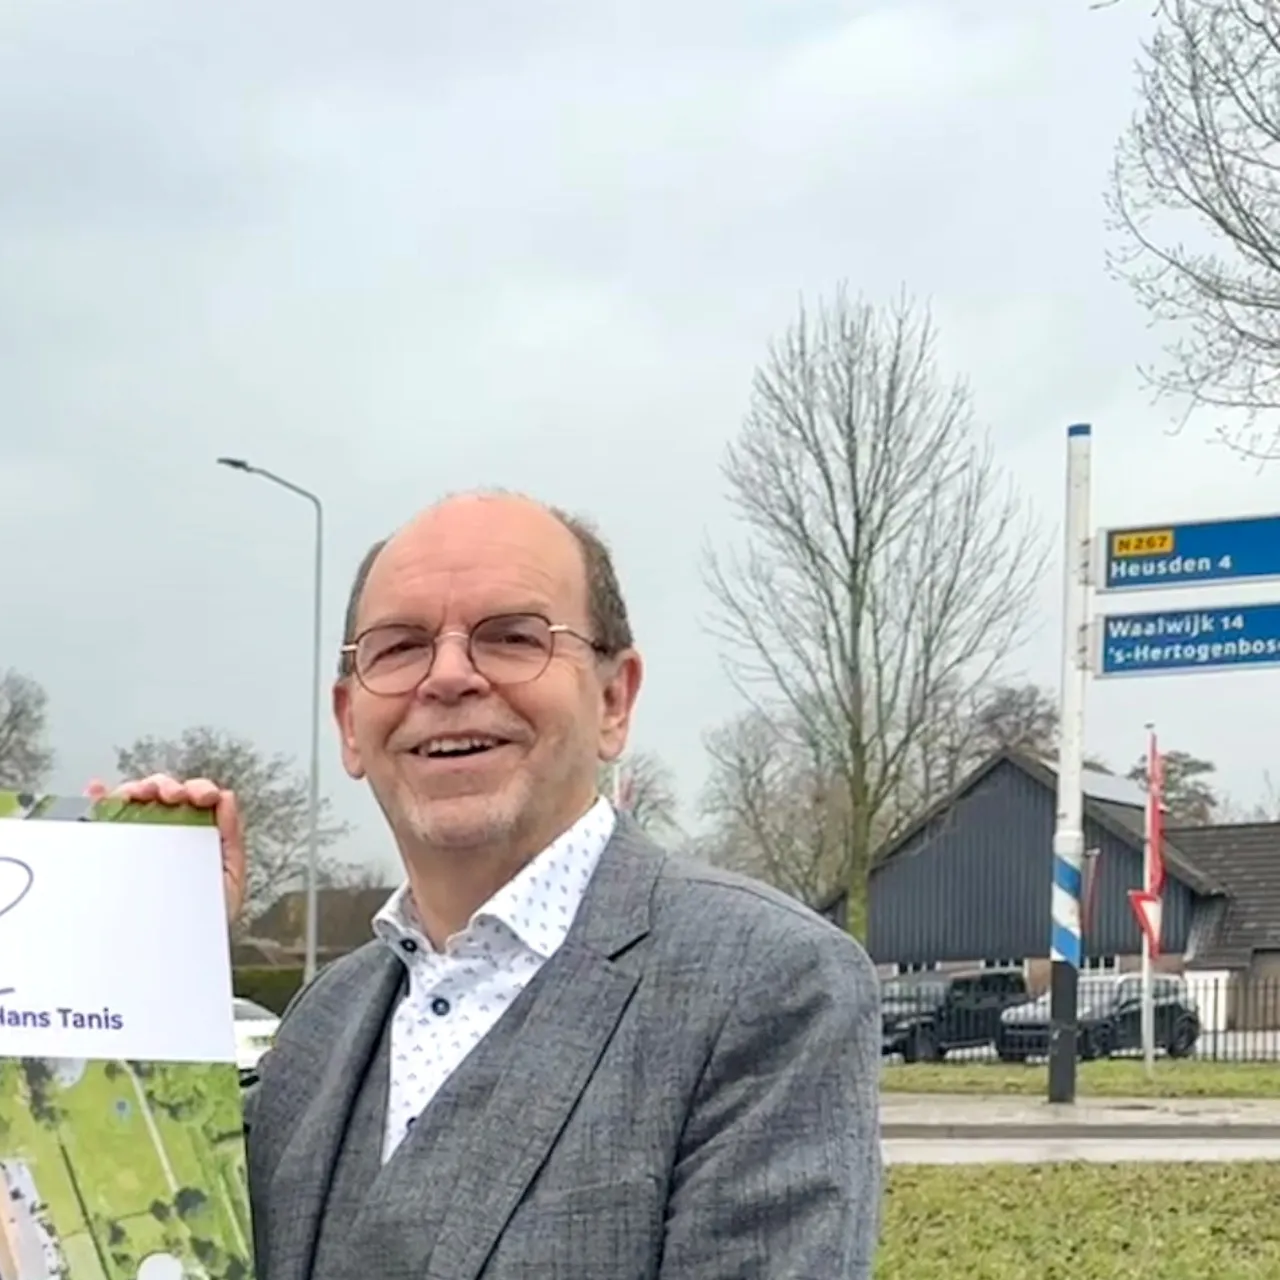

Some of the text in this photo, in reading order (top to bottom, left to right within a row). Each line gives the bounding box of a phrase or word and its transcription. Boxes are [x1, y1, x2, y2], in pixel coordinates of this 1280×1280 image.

[1111, 555, 1233, 578] Heusden 4
[1108, 614, 1244, 638] Waalwijk 14
[57, 1007, 124, 1030] Tanis
